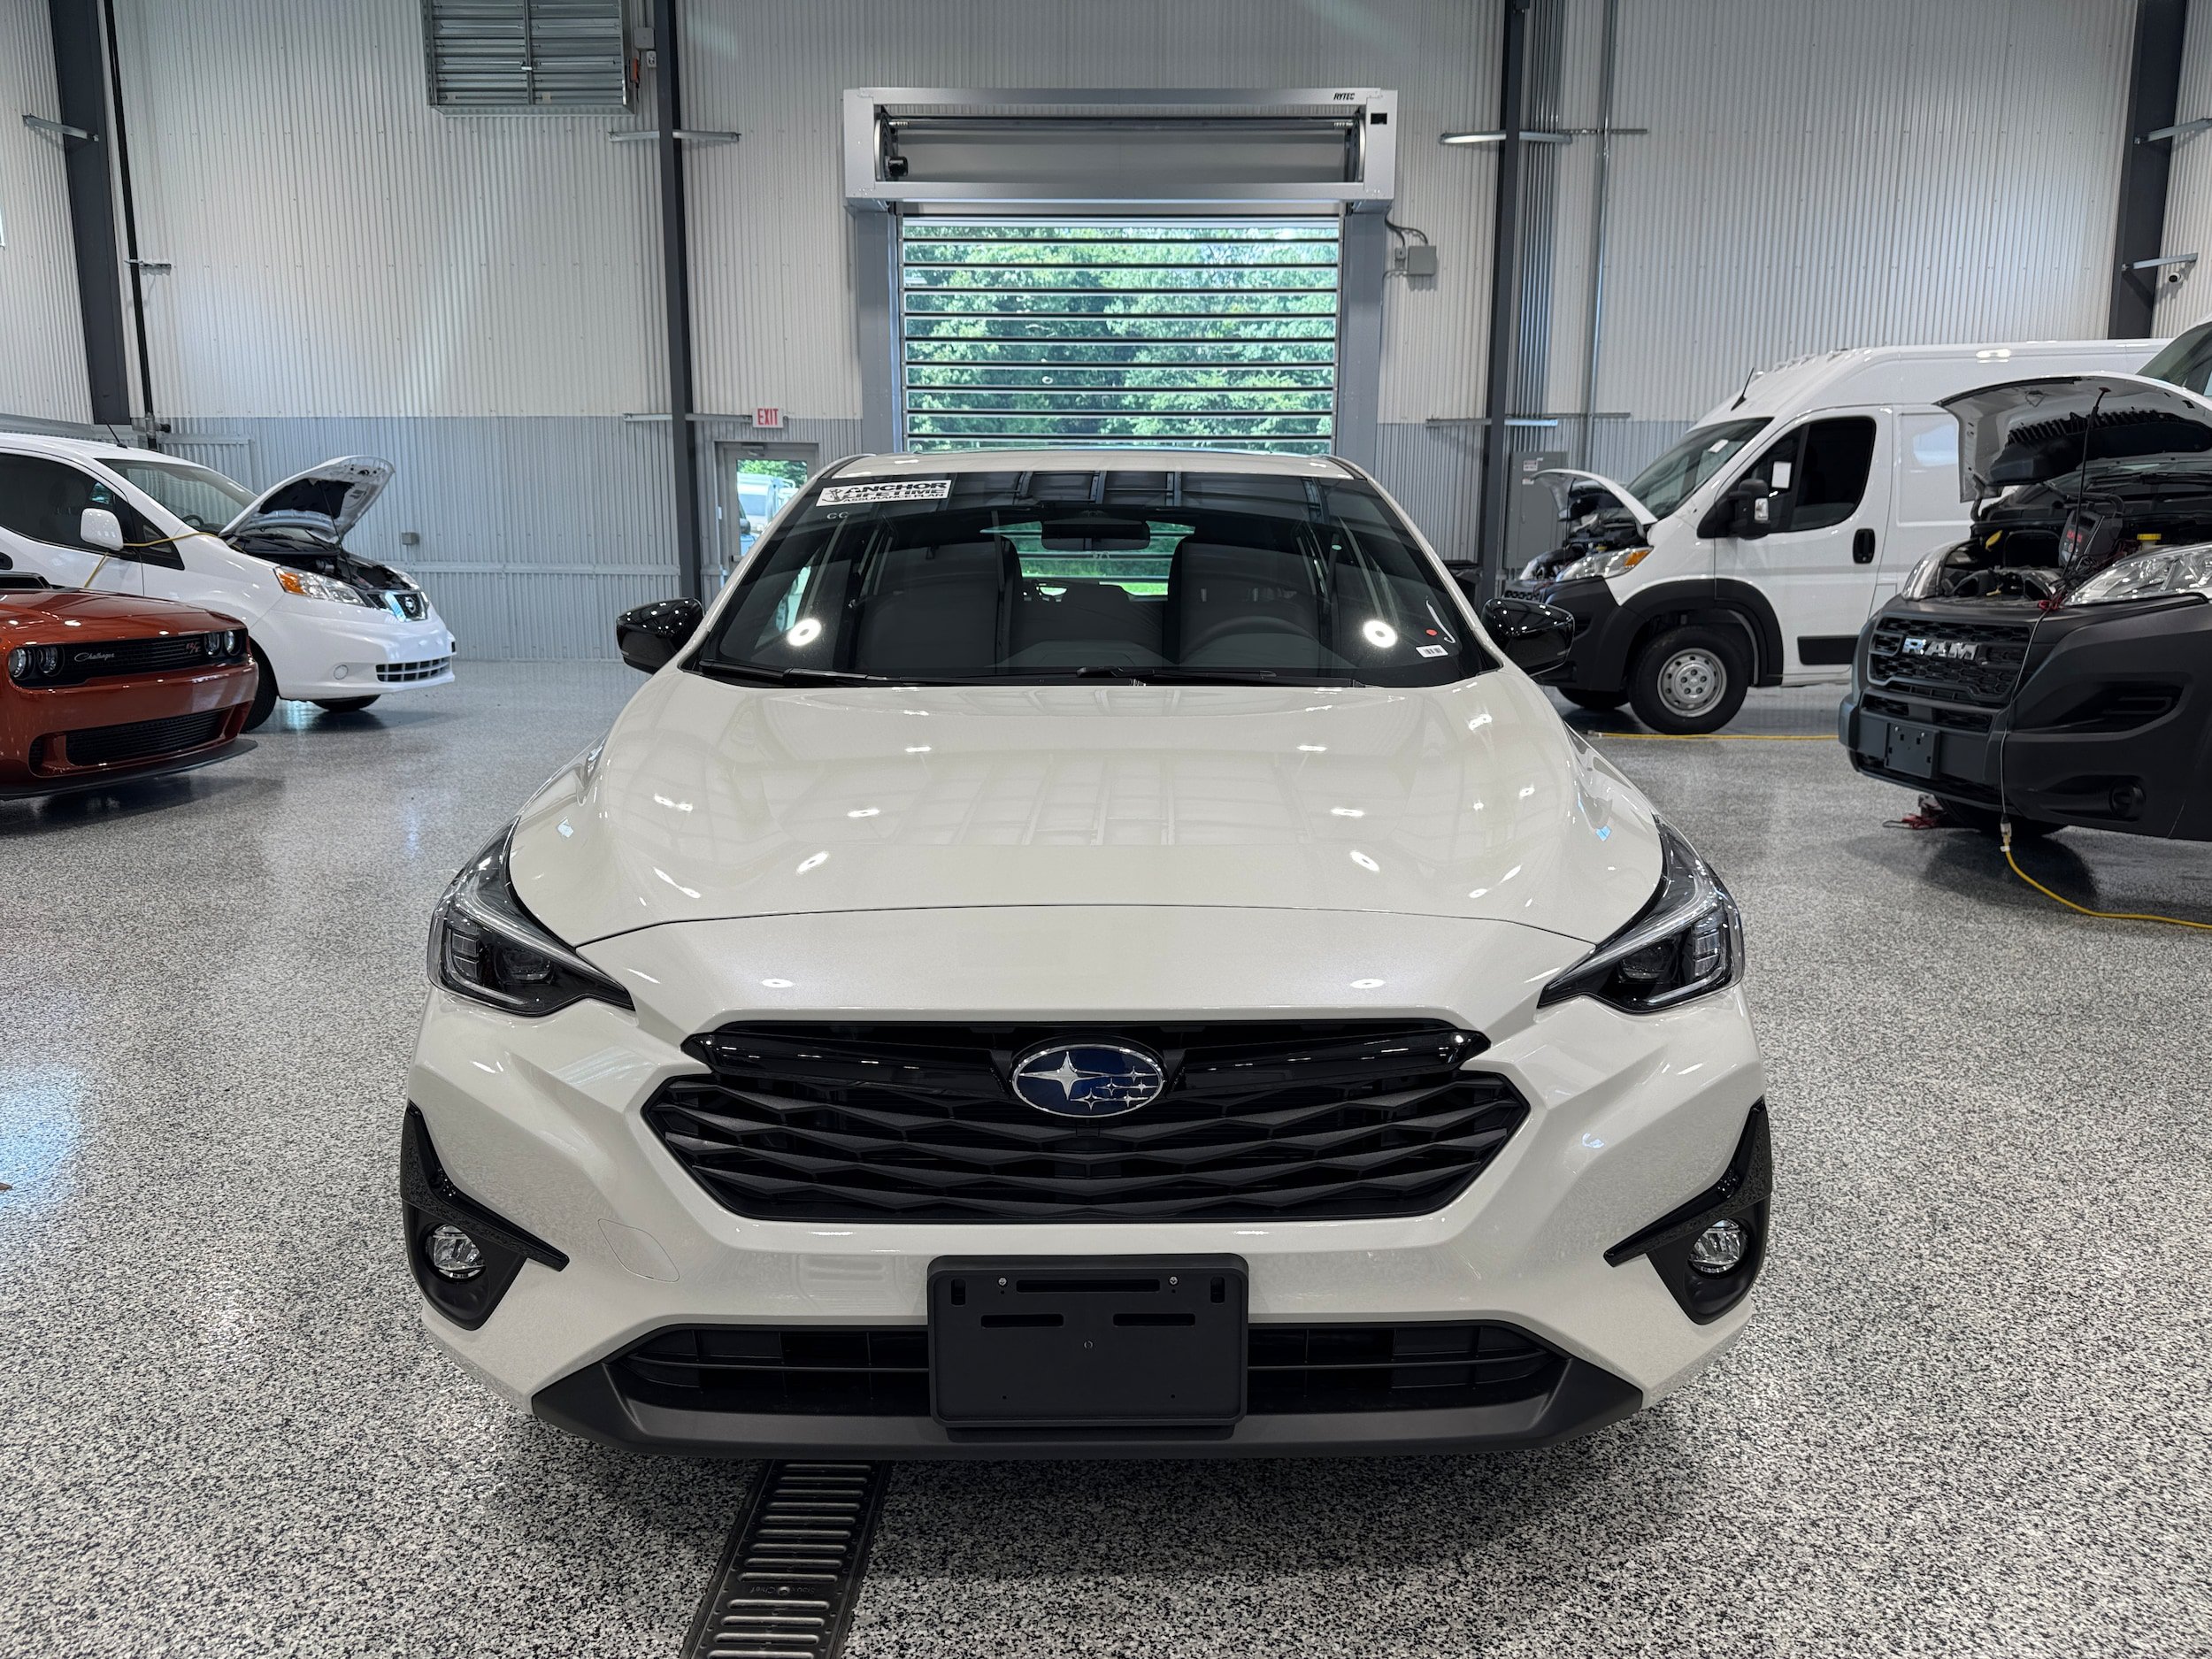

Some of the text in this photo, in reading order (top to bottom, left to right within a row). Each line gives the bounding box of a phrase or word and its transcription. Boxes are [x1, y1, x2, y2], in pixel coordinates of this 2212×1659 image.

[1333, 92, 1356, 101] RYTEC
[757, 408, 779, 426] EXIT
[844, 482, 948, 494] ANCHOR
[841, 489, 945, 500] LIFETIME
[1901, 638, 1978, 661] RAM
